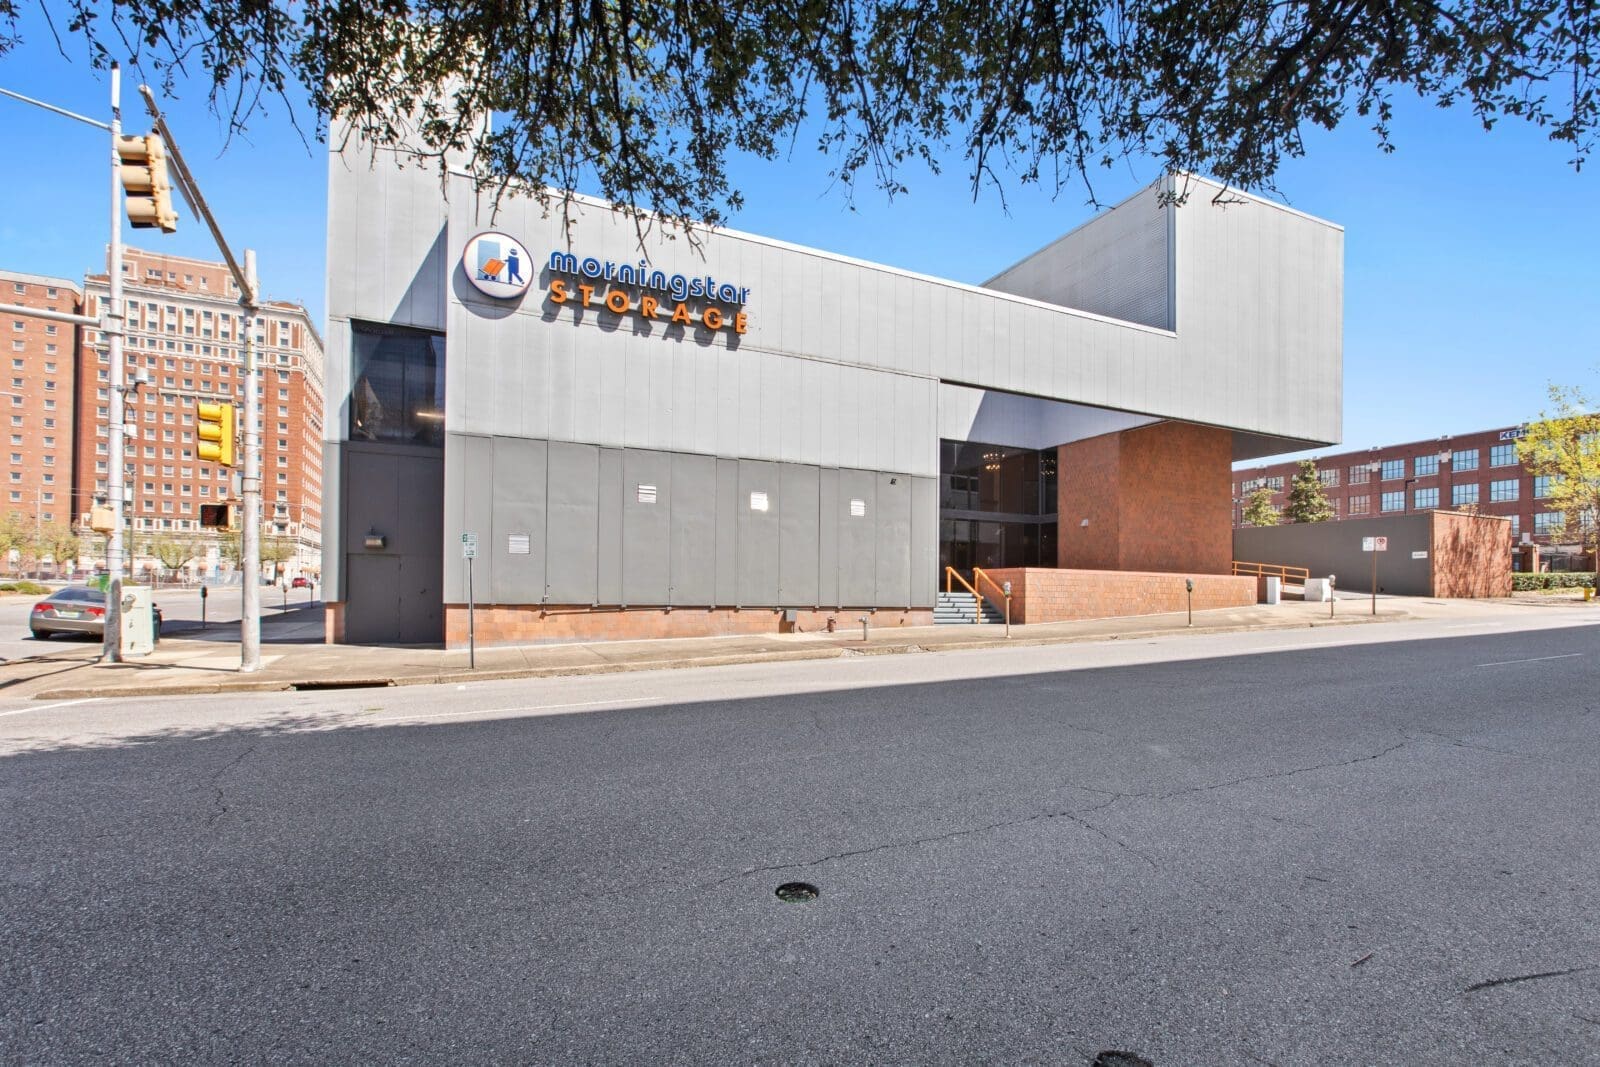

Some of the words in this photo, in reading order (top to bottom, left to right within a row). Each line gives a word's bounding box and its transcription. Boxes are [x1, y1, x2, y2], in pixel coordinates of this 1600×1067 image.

[549, 251, 751, 304] morningstar
[550, 280, 748, 334] STORAGE
[1501, 429, 1529, 438] KEM
